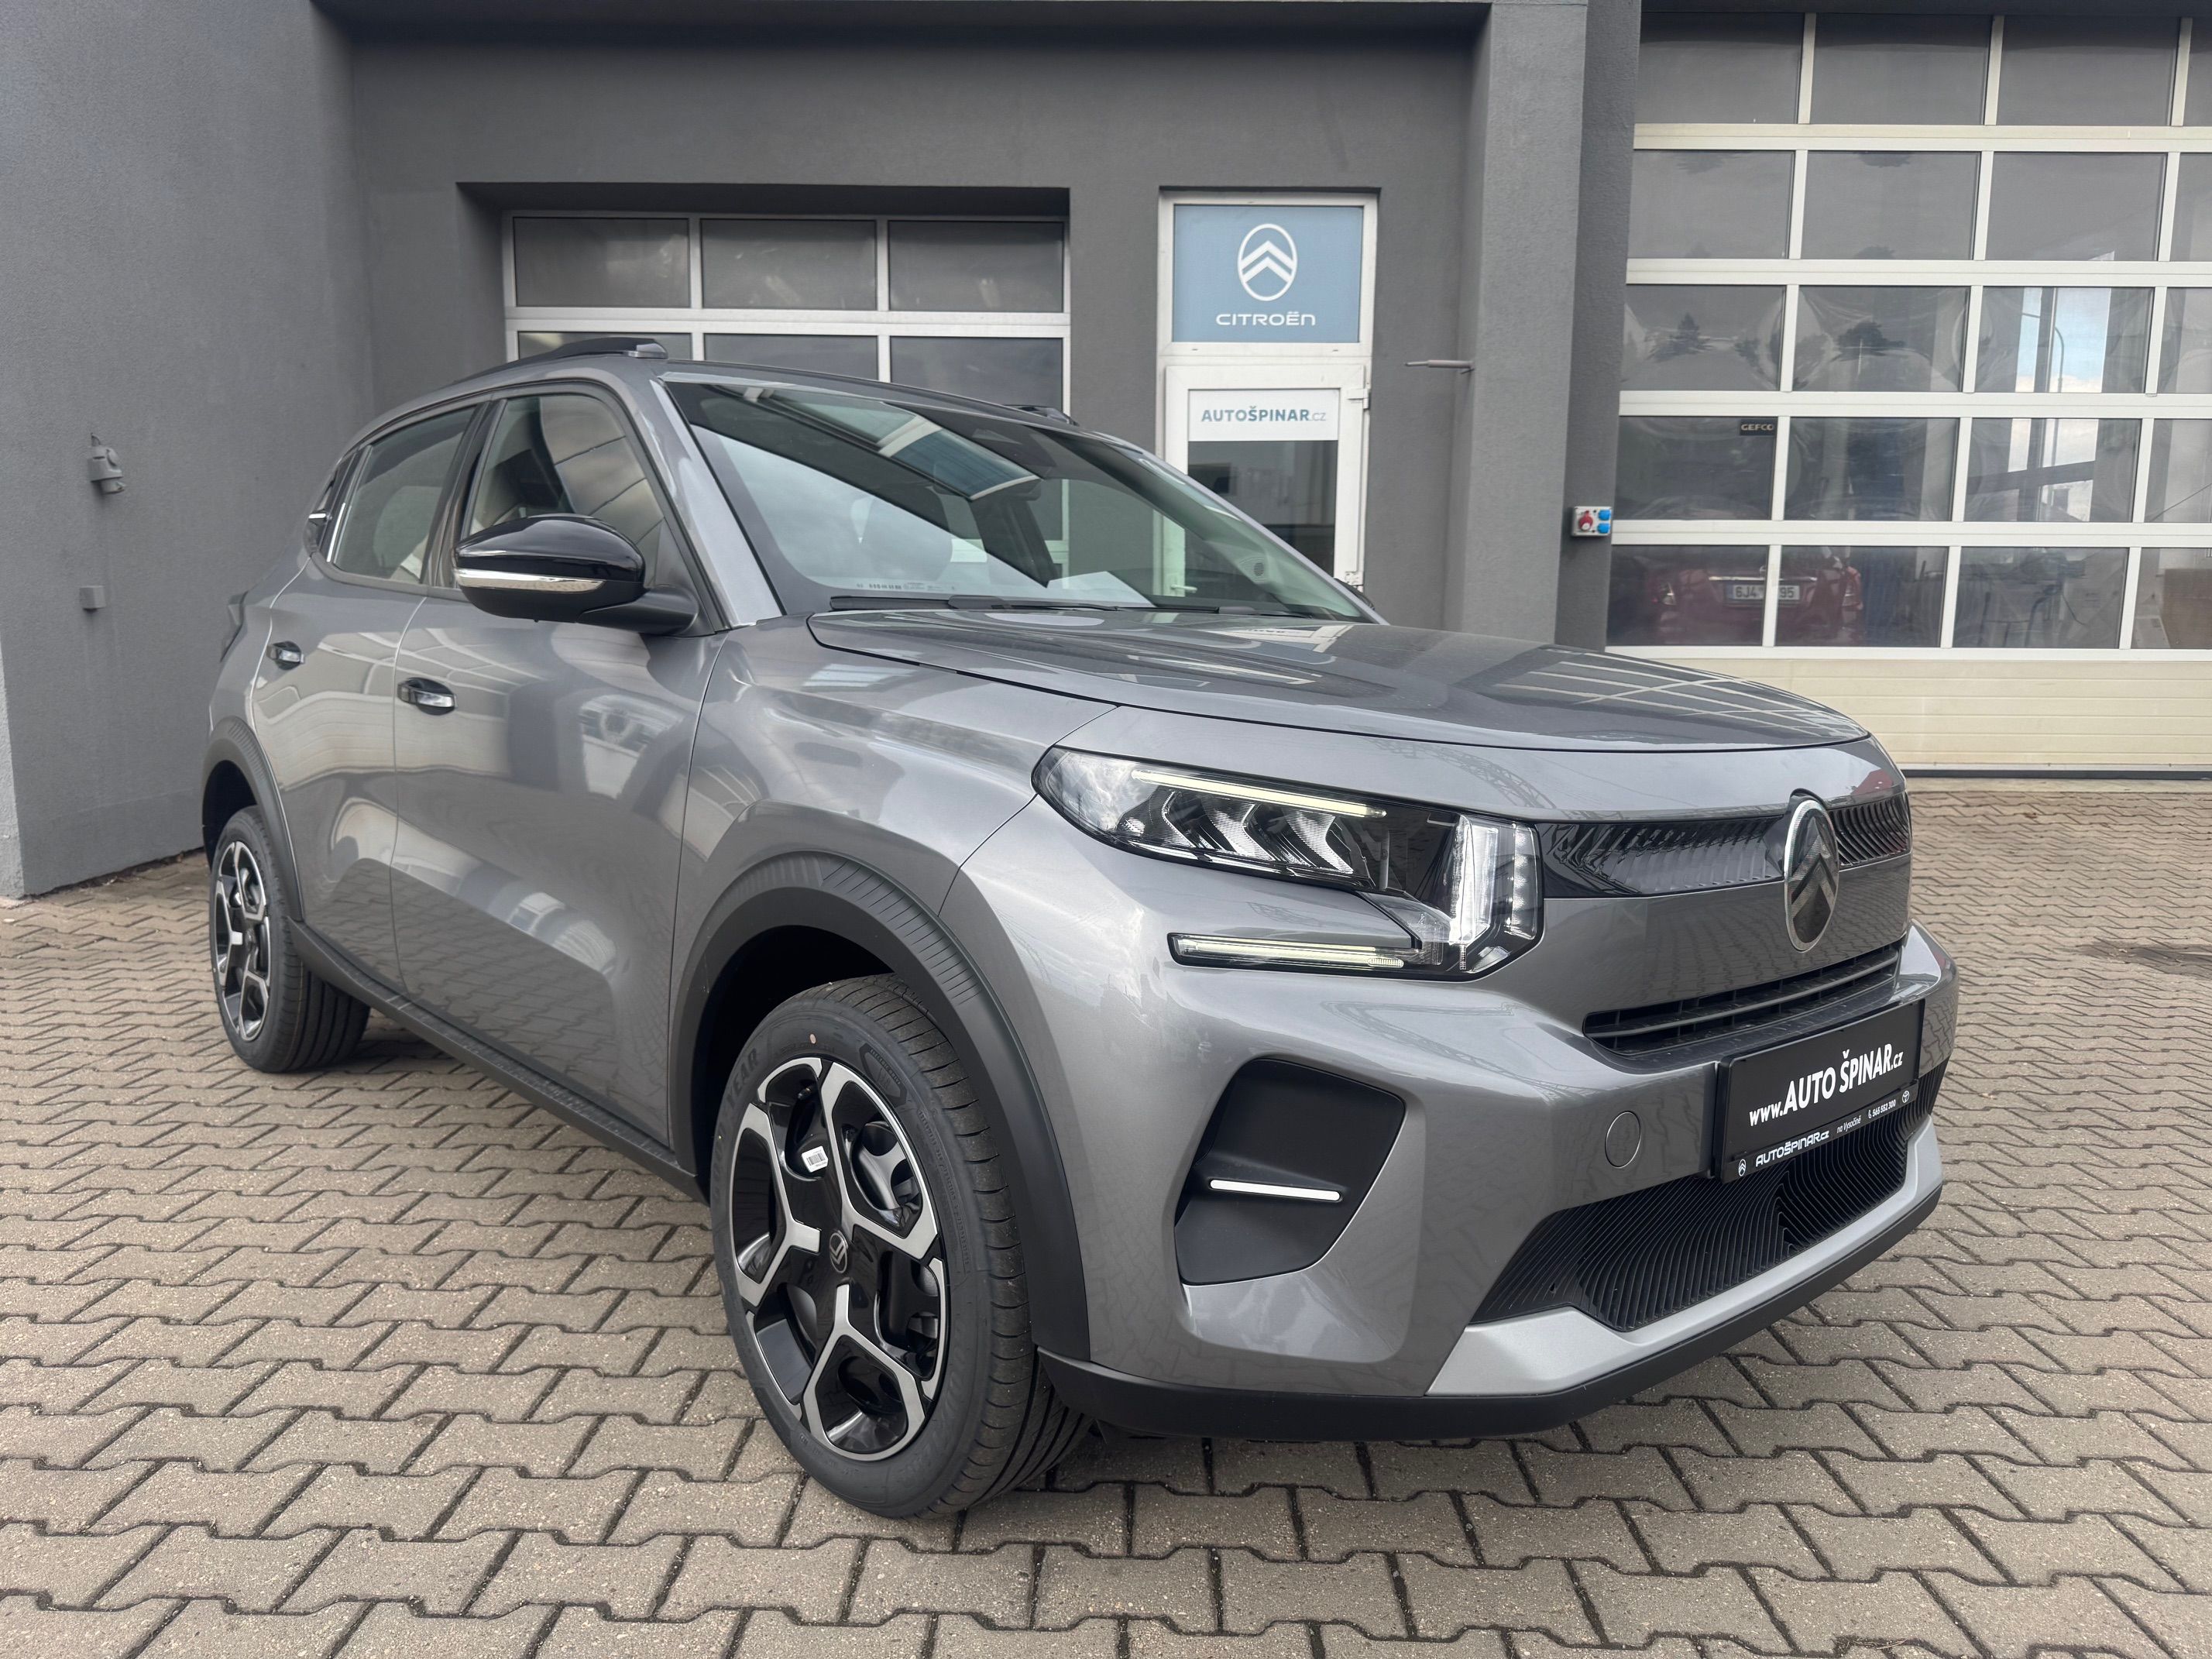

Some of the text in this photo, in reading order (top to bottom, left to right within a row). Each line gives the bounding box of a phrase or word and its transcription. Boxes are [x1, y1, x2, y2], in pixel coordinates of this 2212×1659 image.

[1735, 586, 1757, 598] 6J4
[1749, 1043, 1904, 1126] www.AUTO ŠPINAR.cz
